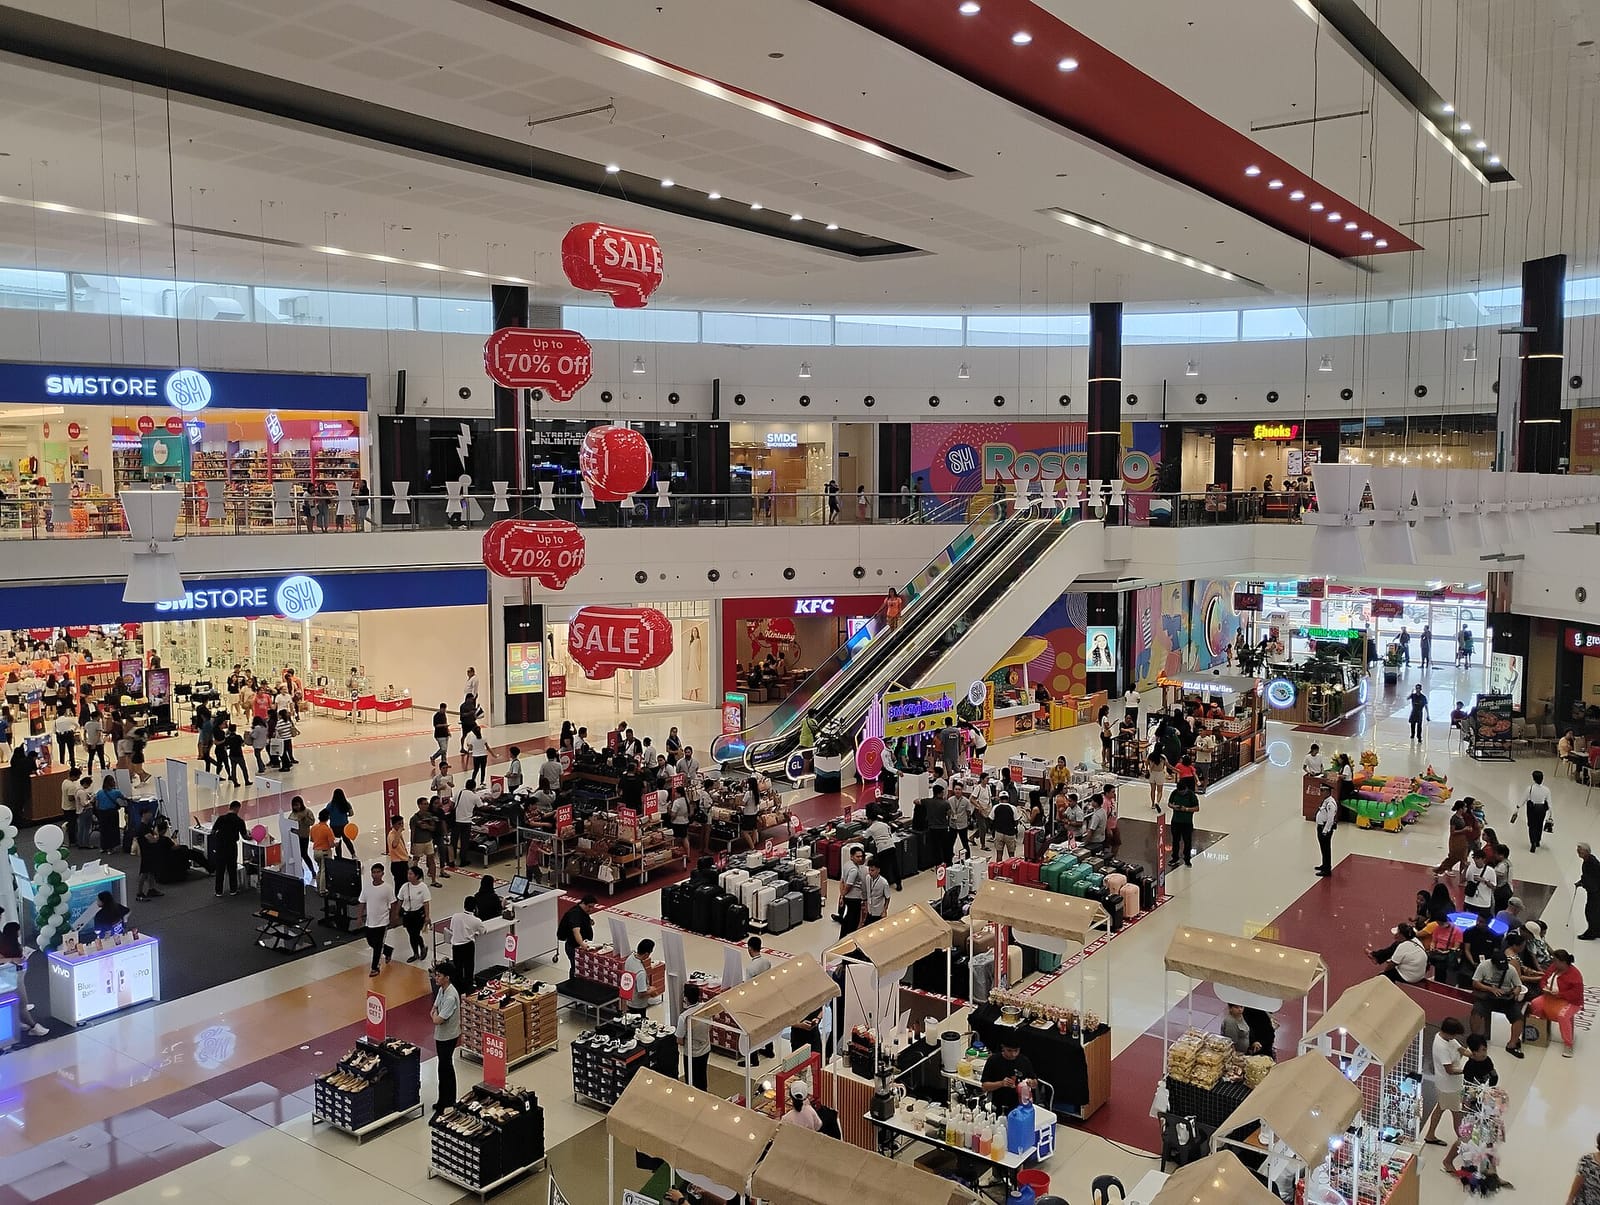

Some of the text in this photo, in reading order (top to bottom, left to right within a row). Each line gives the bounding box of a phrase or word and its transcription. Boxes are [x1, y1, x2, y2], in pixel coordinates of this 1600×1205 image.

[603, 238, 663, 274] SALE
[533, 339, 563, 351] Up to
[505, 353, 588, 375] 70% Off
[767, 433, 798, 443] SMDC
[537, 534, 564, 546] Up to
[510, 548, 585, 568] 70% Off
[795, 599, 835, 614] KFC
[572, 623, 639, 655] SALE
[791, 760, 802, 770] GL
[559, 807, 571, 815] SALE
[51, 964, 71, 978] vivo
[486, 1037, 504, 1050] SALE
